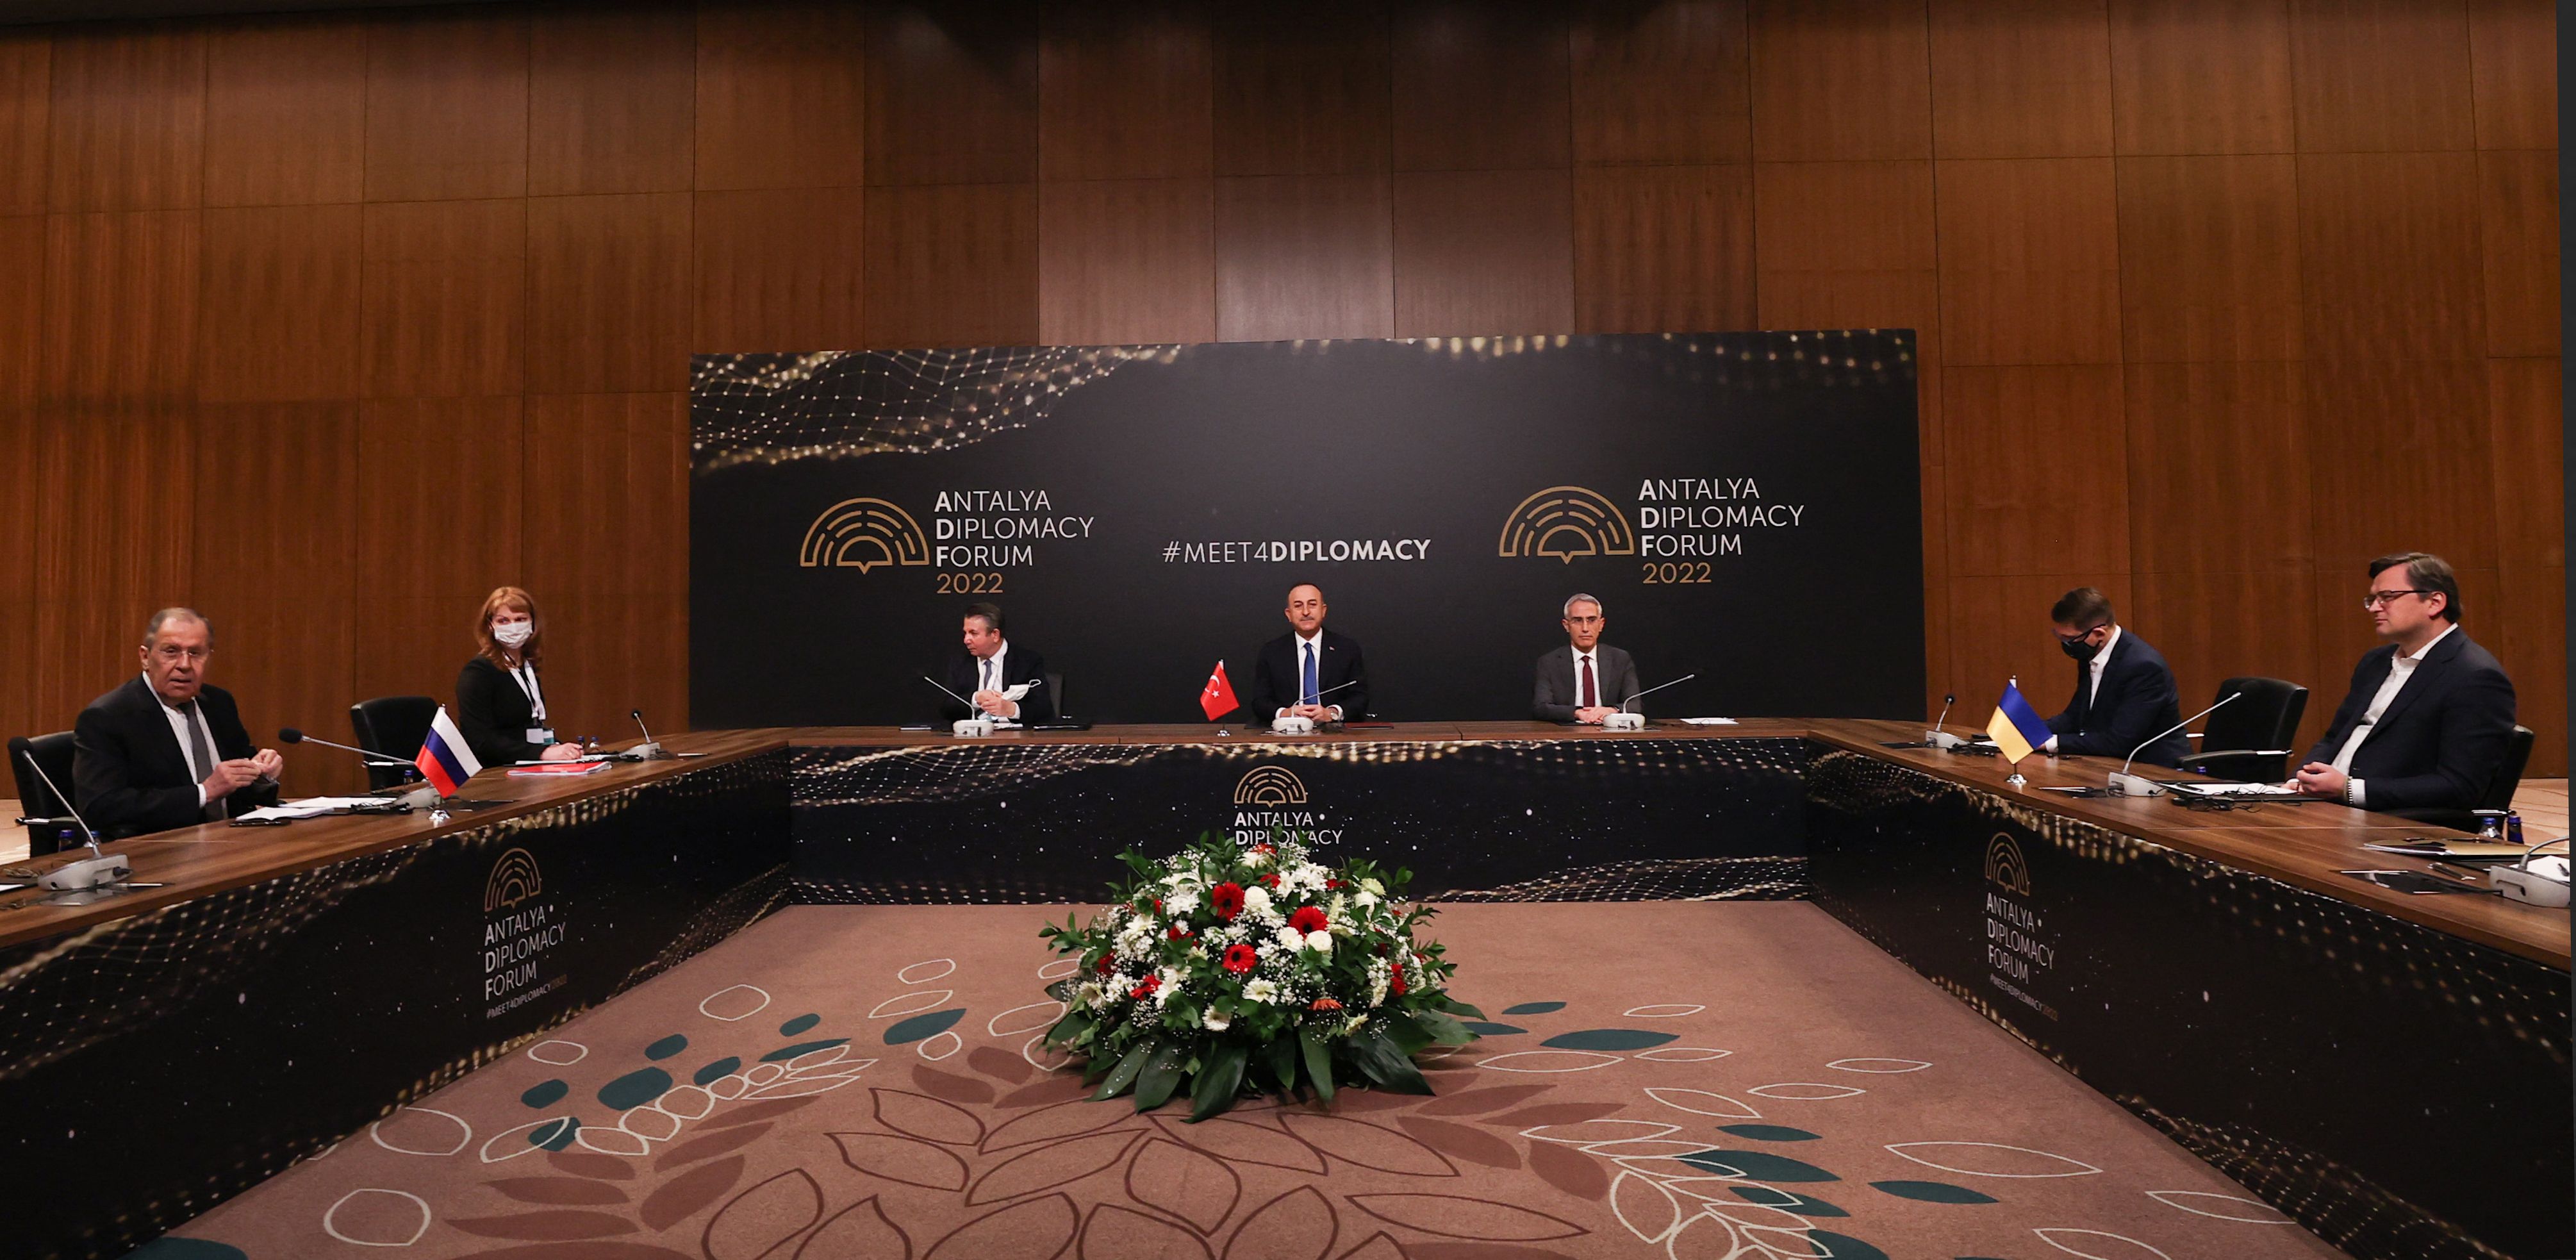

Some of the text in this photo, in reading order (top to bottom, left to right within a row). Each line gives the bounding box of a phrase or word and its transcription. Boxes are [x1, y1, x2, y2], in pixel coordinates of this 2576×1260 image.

[934, 490, 1052, 512] ANTALYA
[1638, 477, 1760, 501] ANTALYA
[936, 516, 1094, 540] DIPLOMACY
[1640, 504, 1804, 529] DIPLOMACY
[936, 545, 1034, 567] FORUM
[1162, 538, 1431, 563] #MEET4DIPLOMACY
[1640, 533, 1742, 556] FORUM
[936, 572, 1003, 594] 2022
[1642, 561, 1712, 584] 2022
[1234, 811, 1314, 827] ANTALYA
[1986, 891, 2035, 933] ANTALYA
[484, 906, 546, 947] ANTALYA
[485, 922, 566, 974] DIPLOMACY
[1987, 917, 2054, 970] DIPLOMACY
[1988, 943, 2029, 984] FORUM
[485, 961, 537, 1001] FORUM
